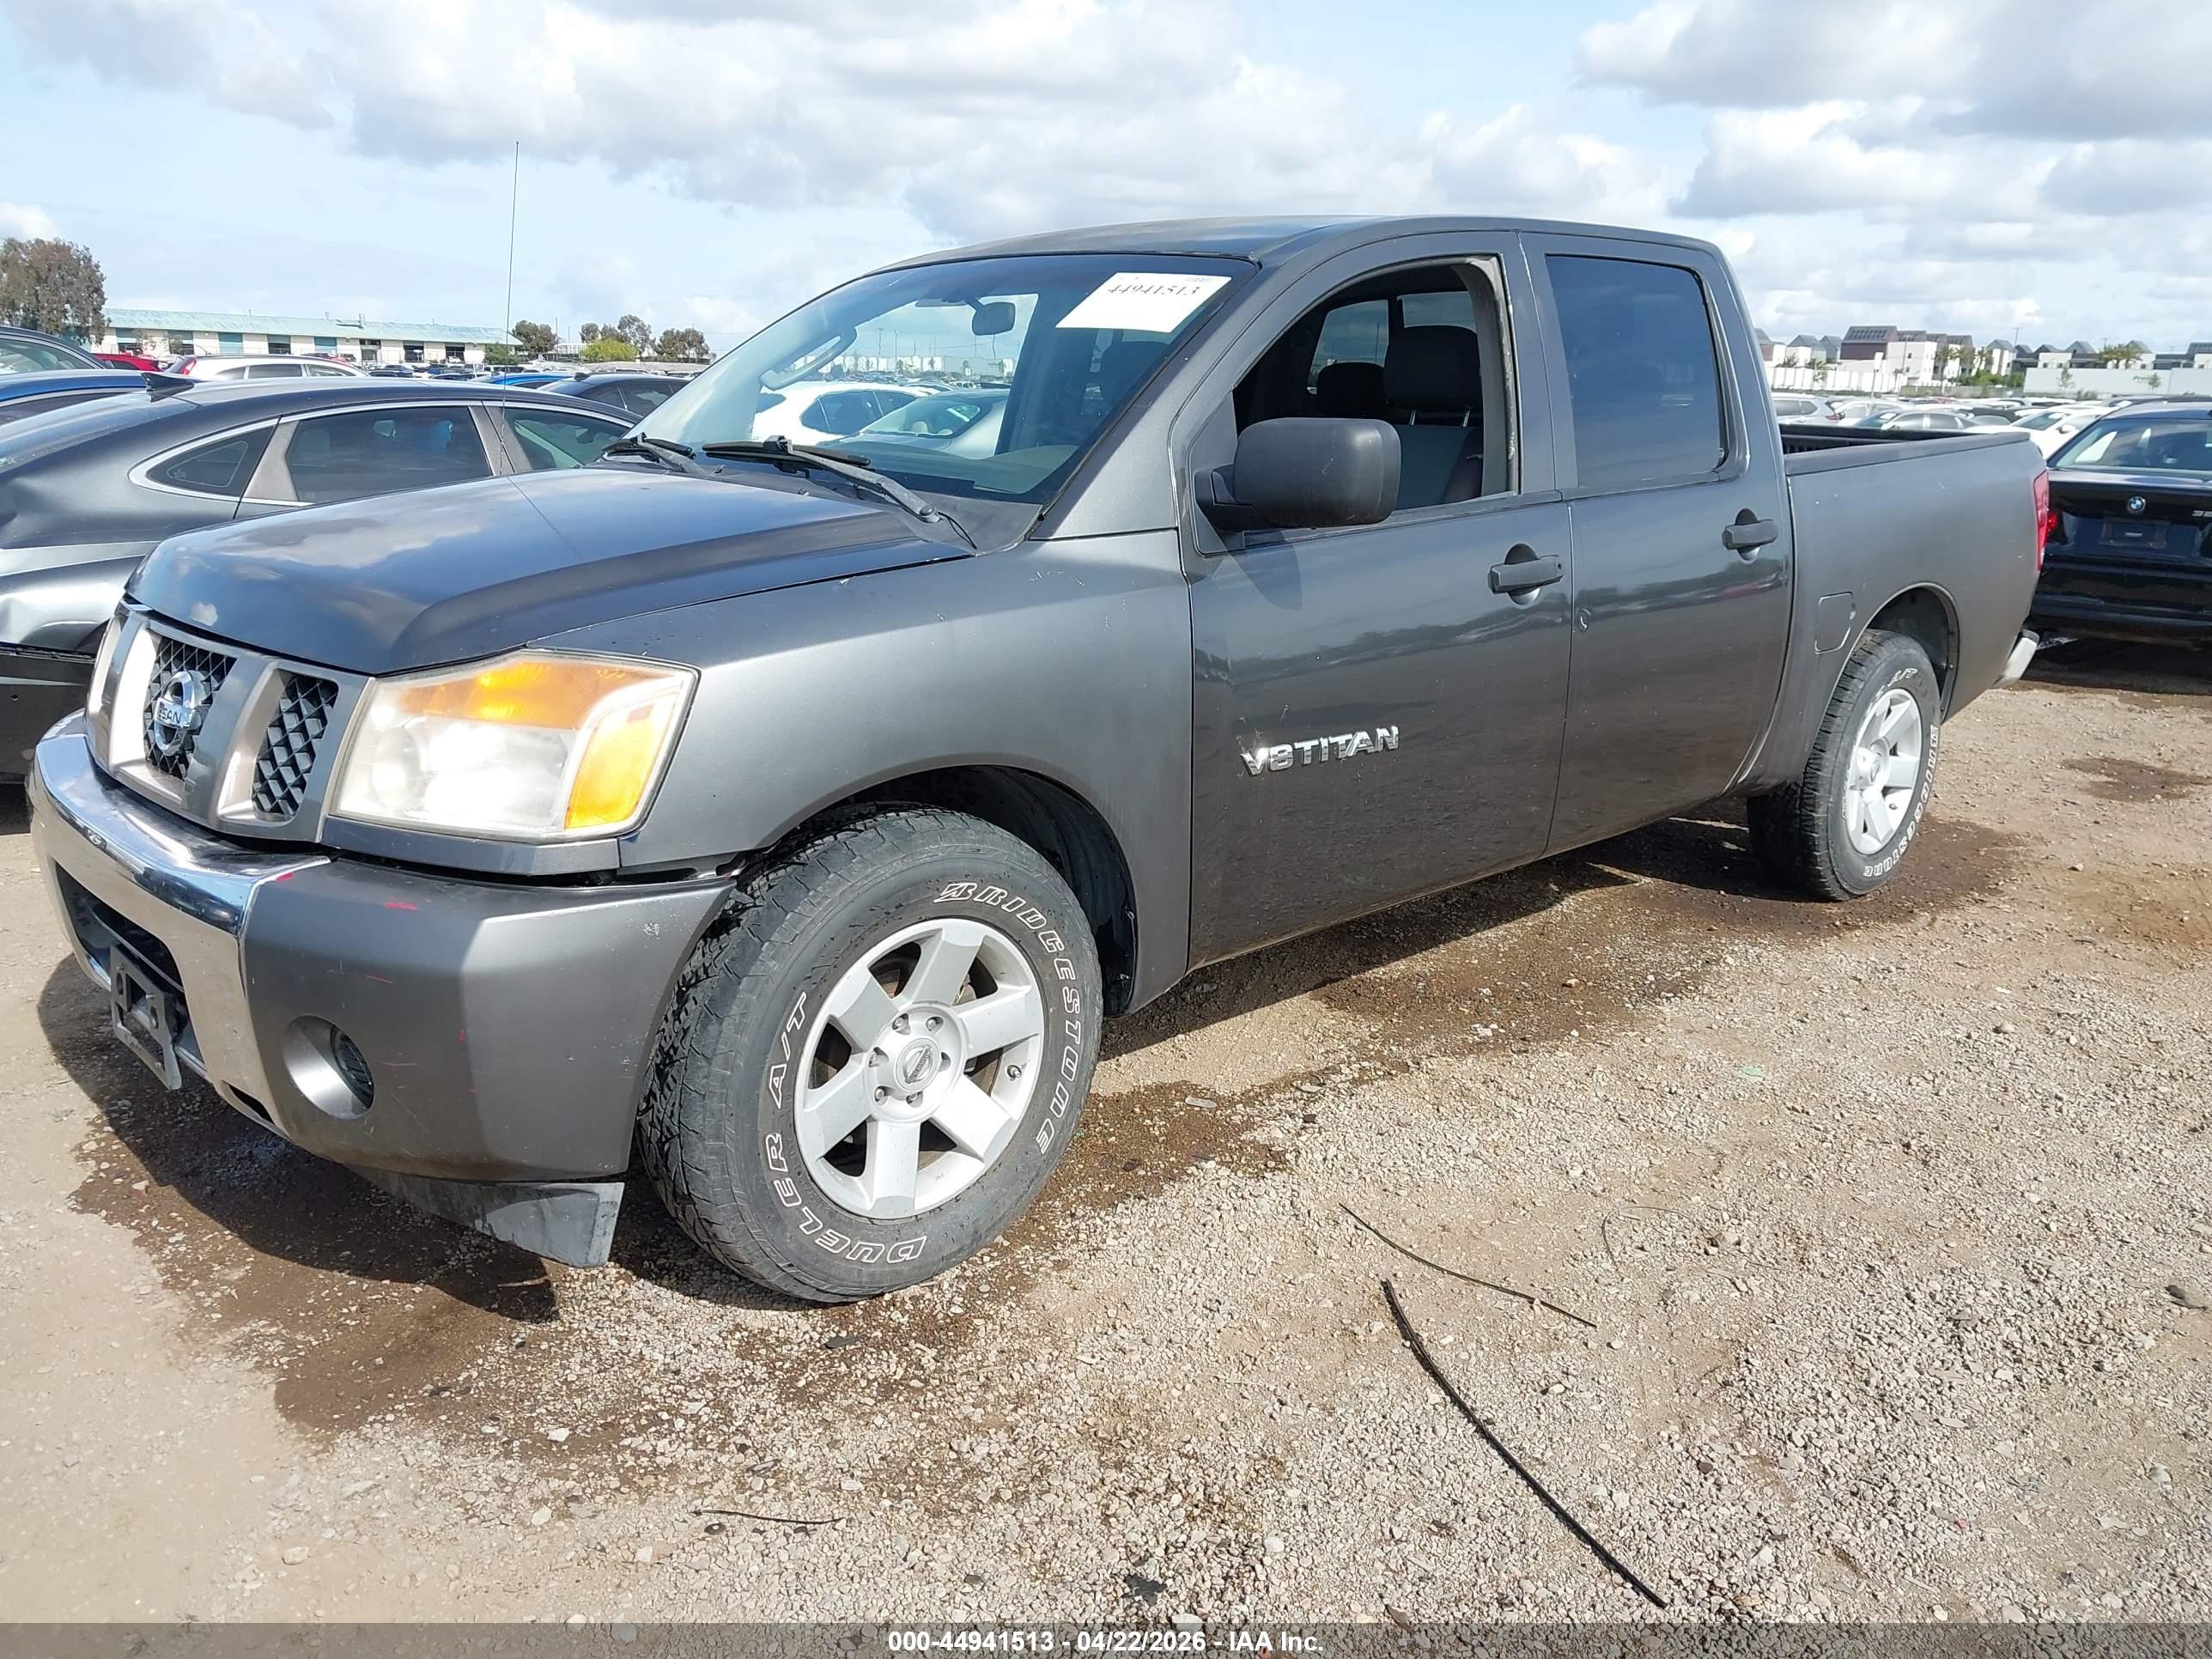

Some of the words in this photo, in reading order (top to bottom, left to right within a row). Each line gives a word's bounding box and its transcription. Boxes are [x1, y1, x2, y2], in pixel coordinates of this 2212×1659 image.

[769, 991, 807, 1109] A/T
[933, 882, 1081, 1154] BRIDGESTONE
[765, 1133, 927, 1263] DUELER
